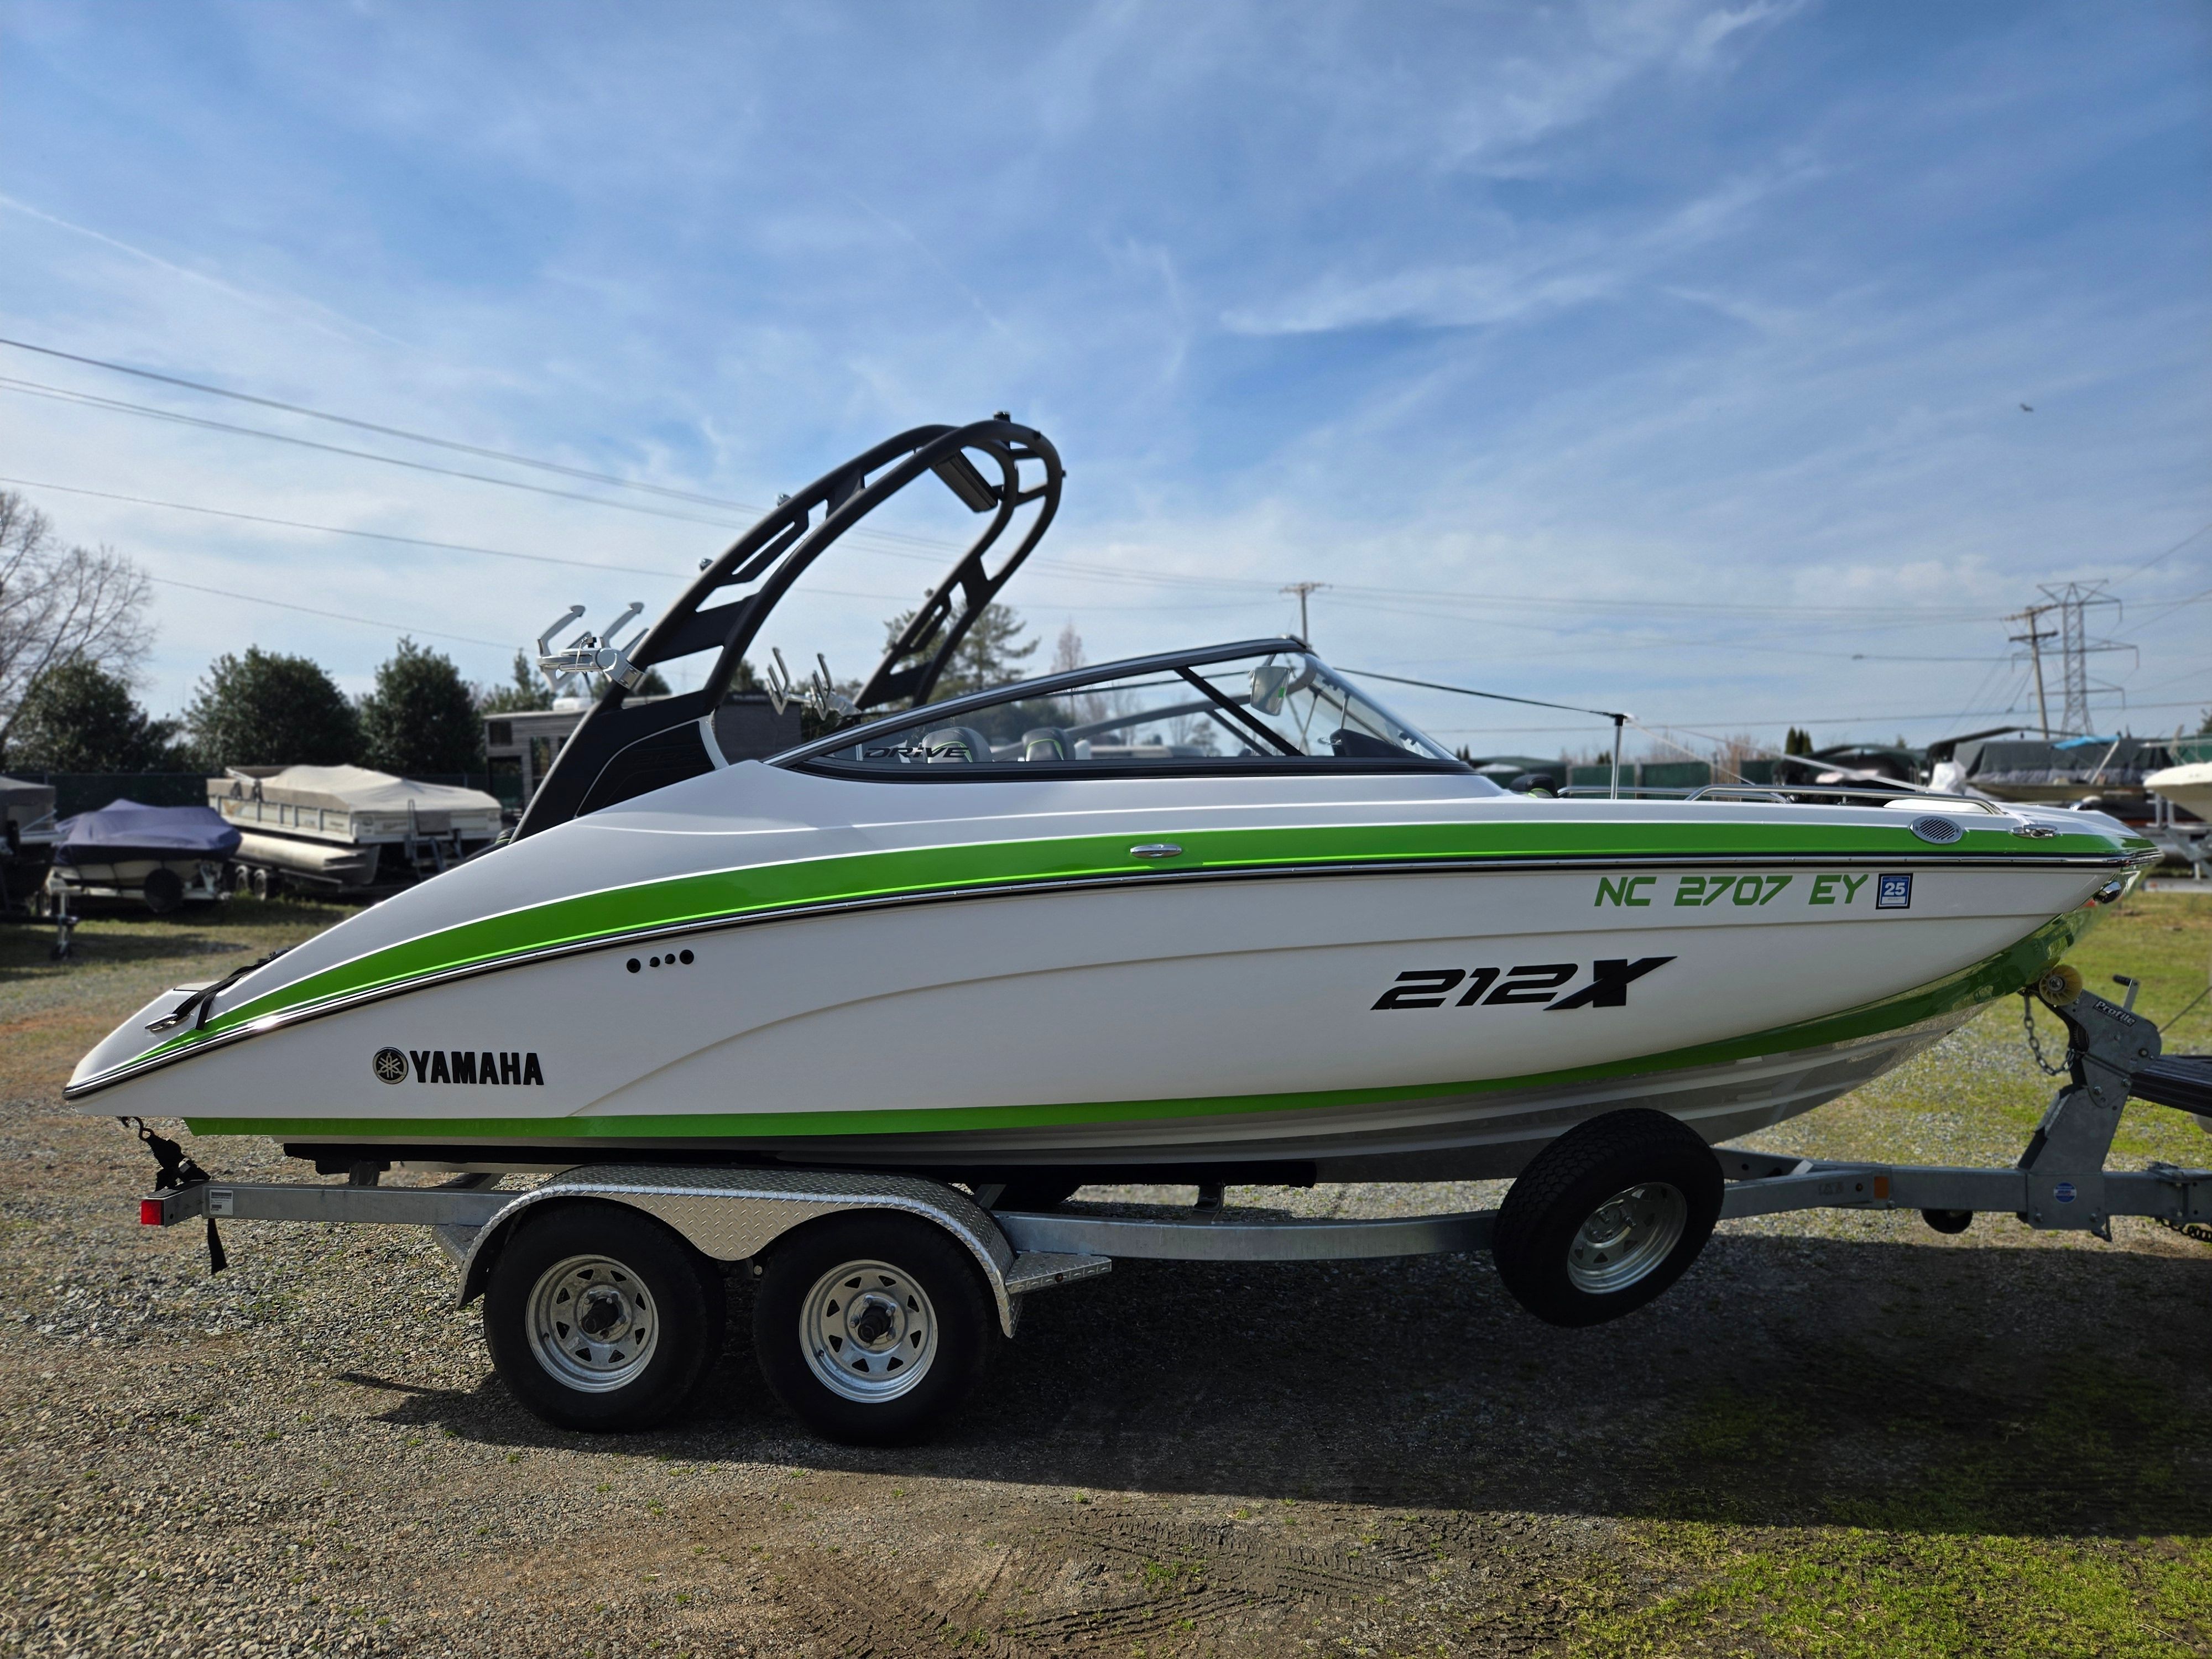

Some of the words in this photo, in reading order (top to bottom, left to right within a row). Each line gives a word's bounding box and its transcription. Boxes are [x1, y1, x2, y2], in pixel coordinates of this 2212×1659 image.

[1594, 877, 1657, 906] NC
[1674, 875, 1792, 906] 2707
[1809, 874, 1868, 905] EY
[1884, 882, 1906, 896] 25
[1370, 956, 1678, 1011] 212X
[2095, 1001, 2136, 1024] Profile
[410, 1051, 544, 1085] YAMAHA
